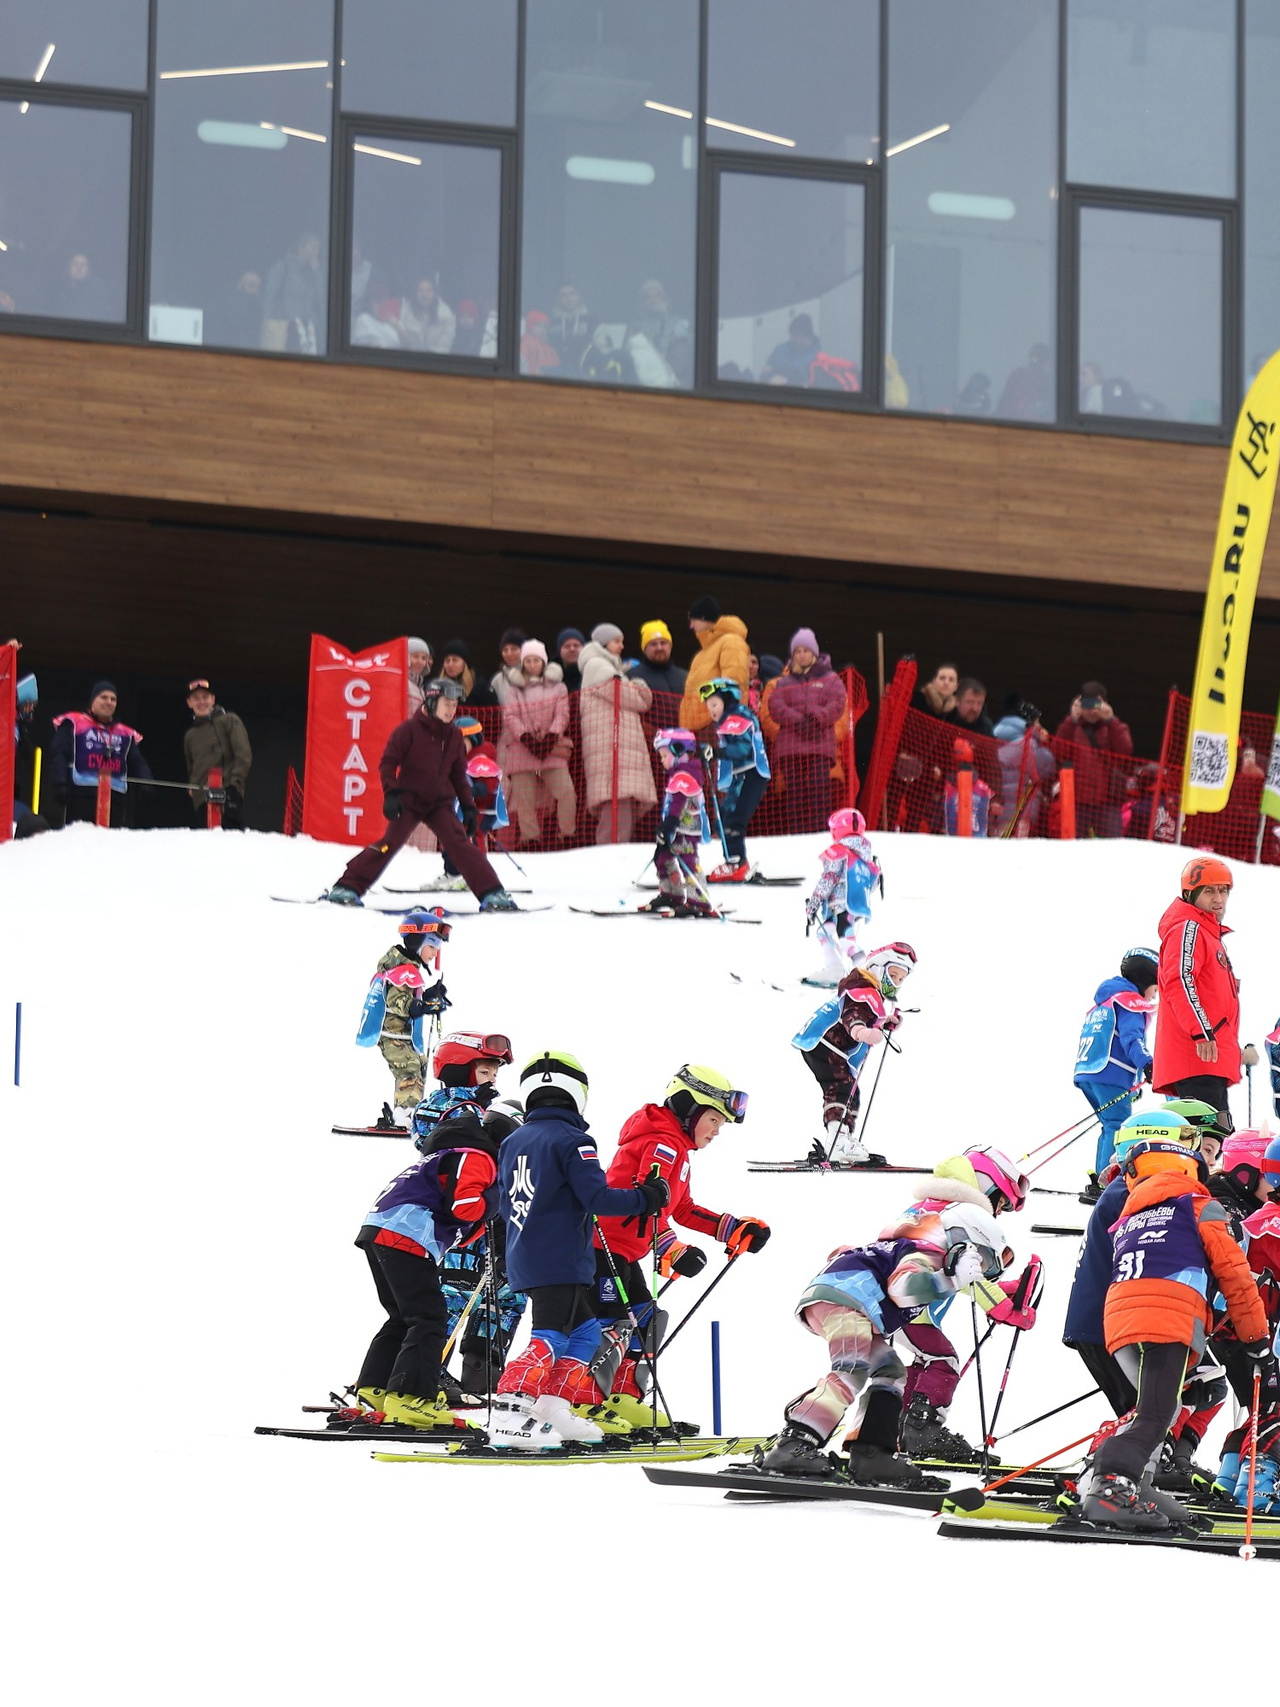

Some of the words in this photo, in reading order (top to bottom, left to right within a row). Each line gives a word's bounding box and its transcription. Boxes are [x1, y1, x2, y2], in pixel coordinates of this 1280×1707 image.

[342, 678, 372, 836] СТАРТ
[1160, 1144, 1195, 1157] BRIKO
[400, 1403, 438, 1420] FISCHER
[495, 1428, 532, 1439] HEAD
